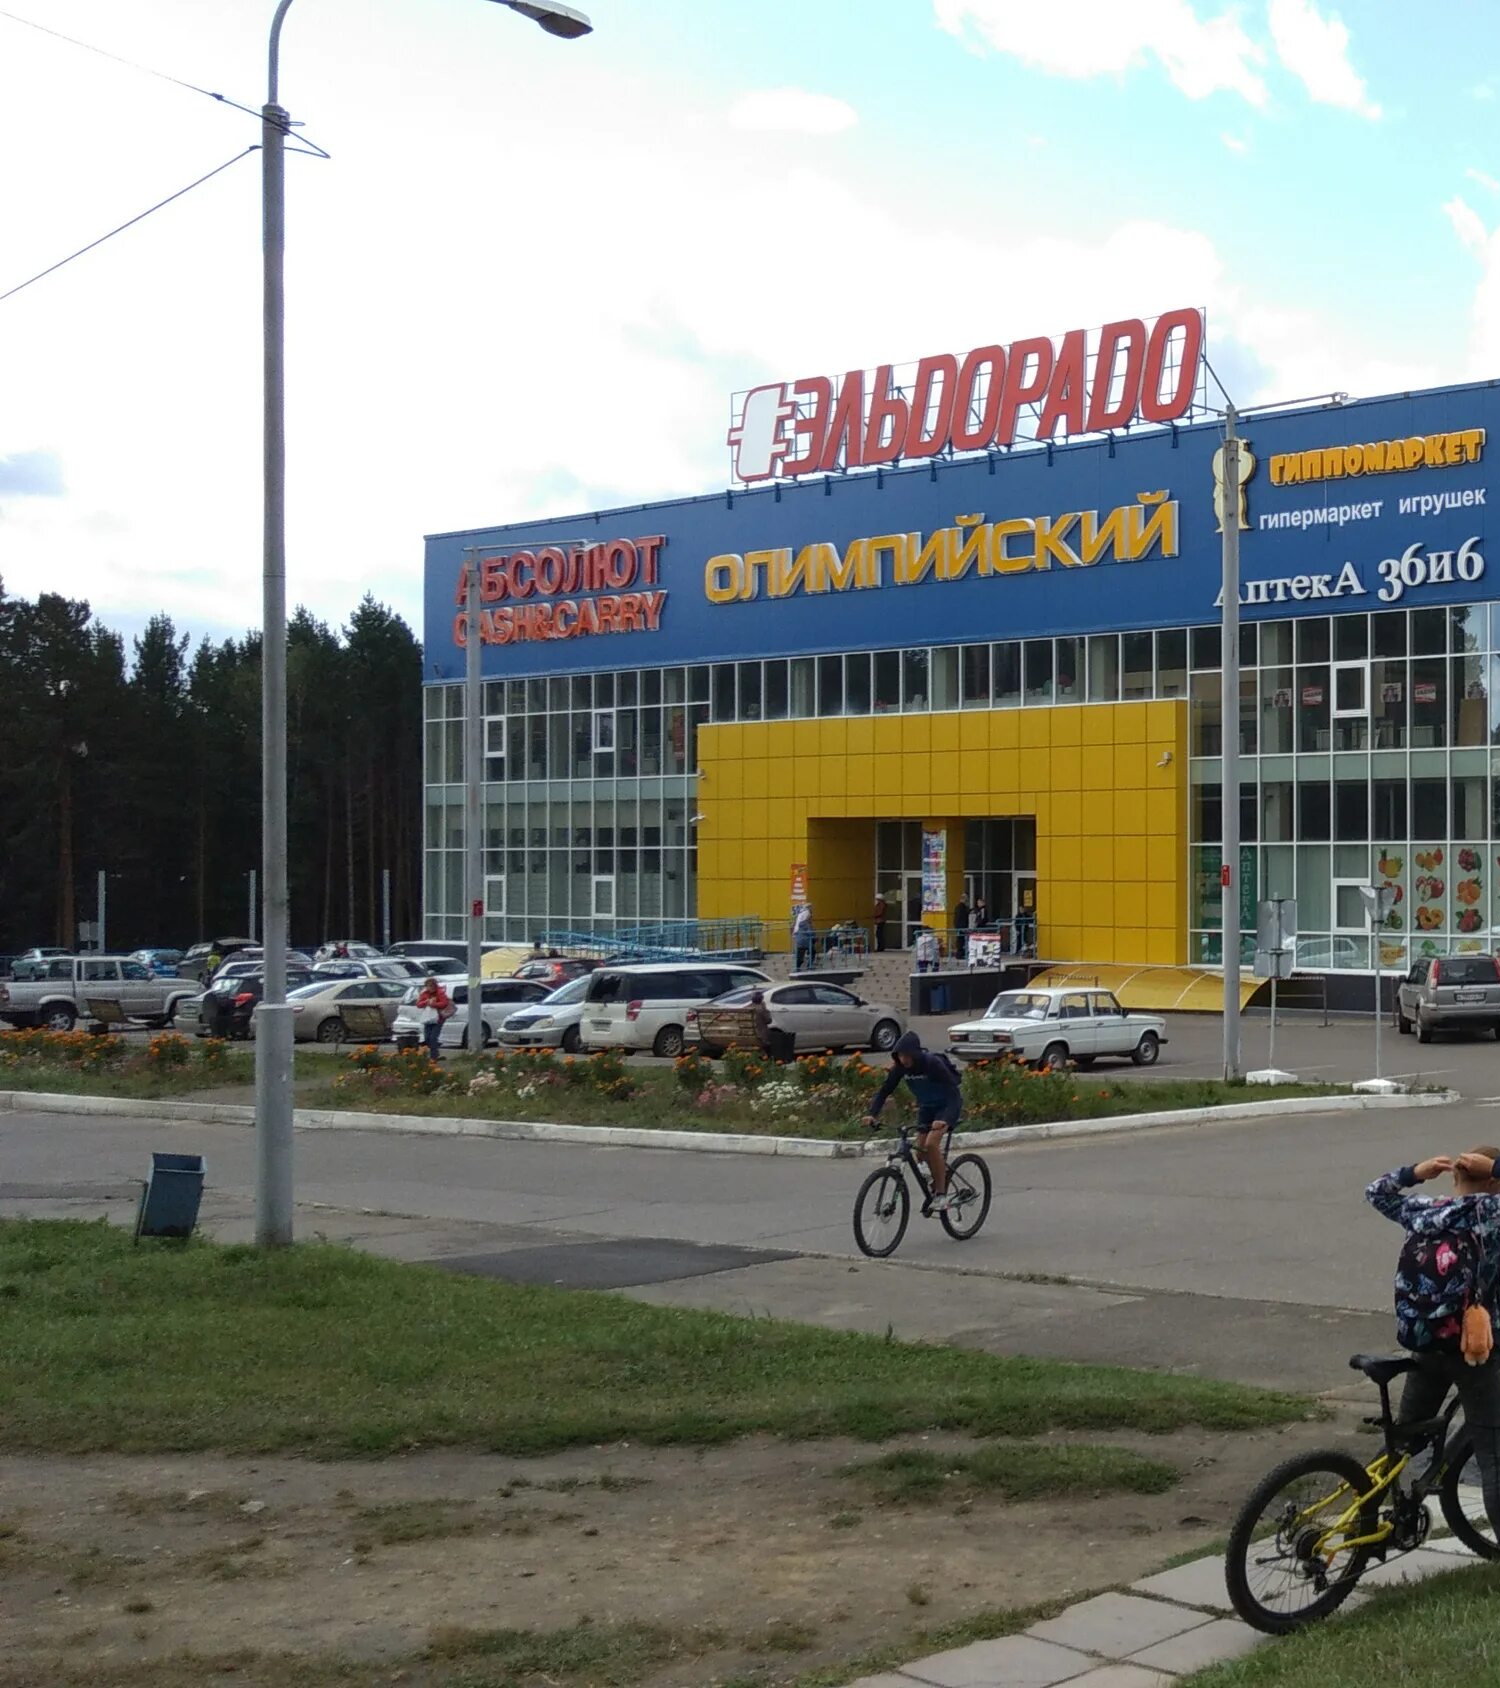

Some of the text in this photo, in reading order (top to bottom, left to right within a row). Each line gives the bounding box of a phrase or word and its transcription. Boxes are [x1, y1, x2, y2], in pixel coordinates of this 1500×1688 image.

[1269, 428, 1487, 486] ГИППОМАРКЕТ
[1259, 487, 1486, 530] гипермаркет игрушек
[705, 490, 1179, 604] ОЛИМПИЙСКИЙ
